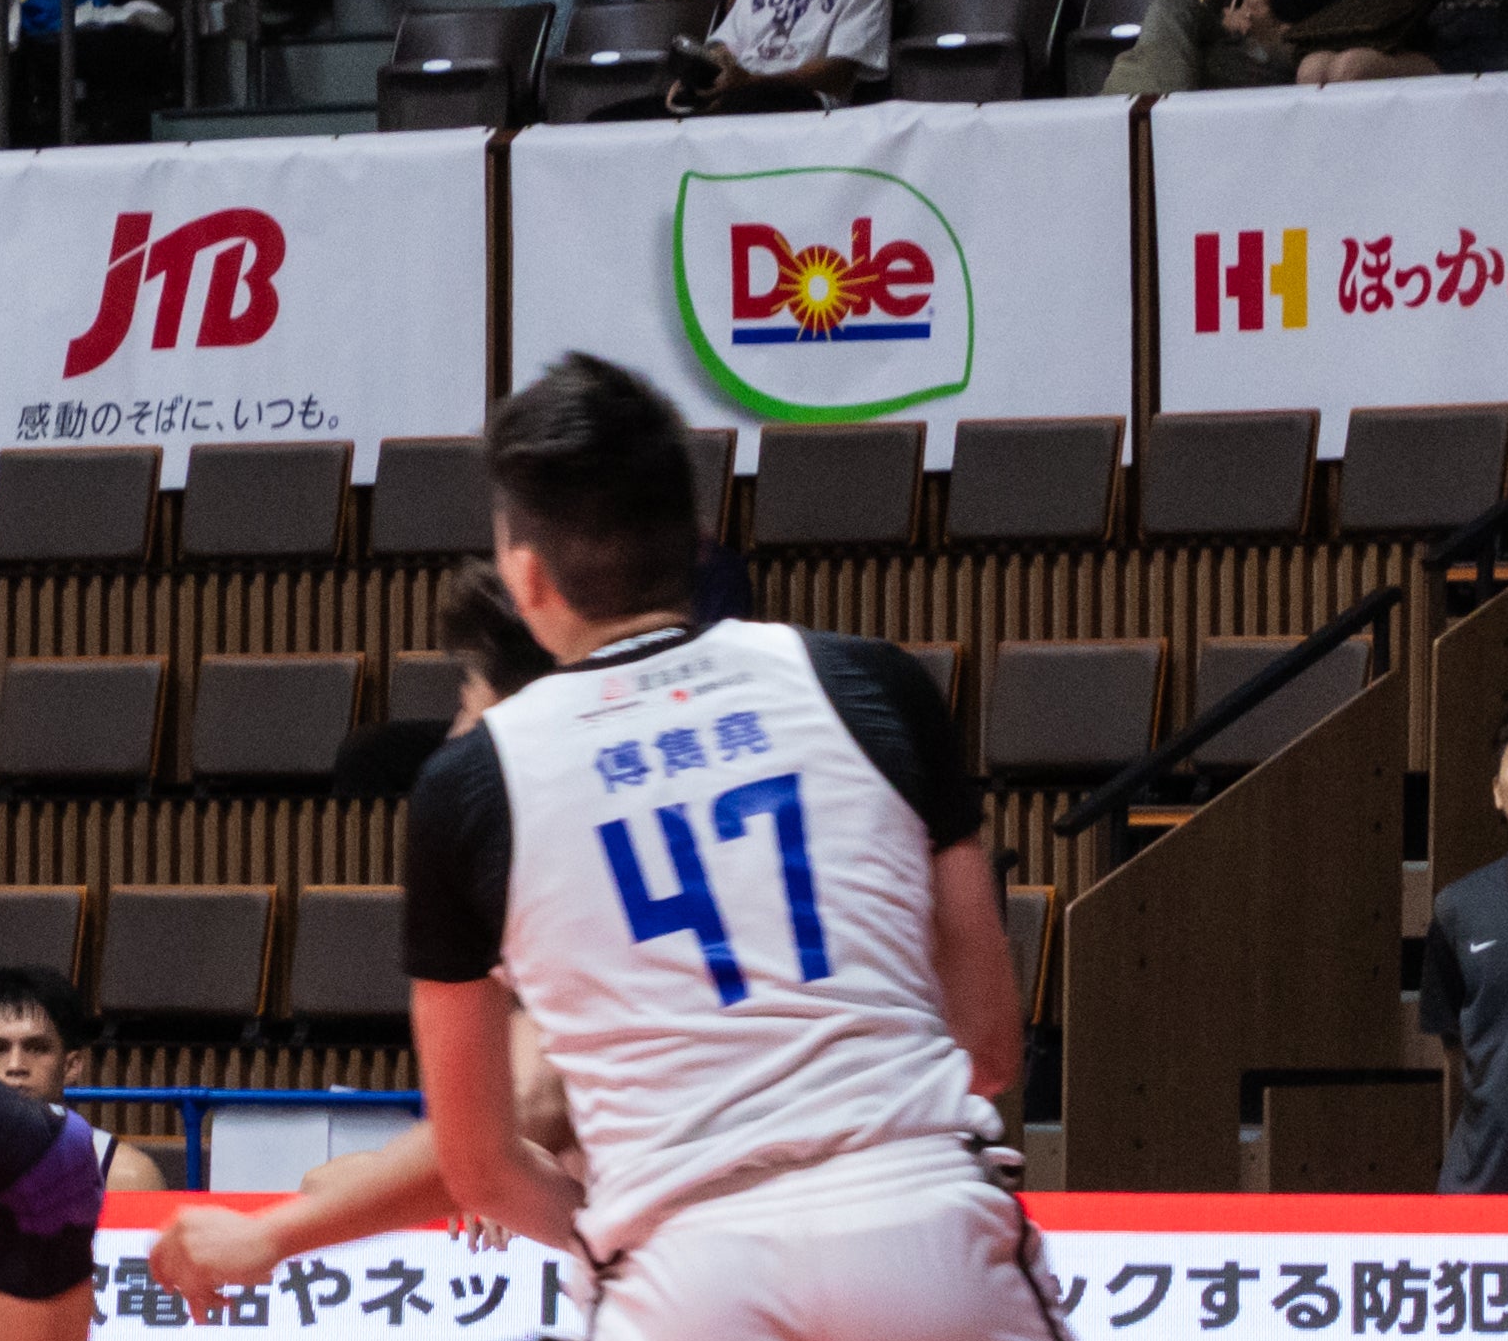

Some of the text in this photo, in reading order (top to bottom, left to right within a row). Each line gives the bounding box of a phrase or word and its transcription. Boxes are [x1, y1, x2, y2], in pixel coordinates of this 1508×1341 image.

[62, 206, 287, 379] JTB
[729, 215, 936, 328] Dole
[16, 392, 341, 442] 感動のそばに、いつも。
[594, 771, 835, 1008] 47
